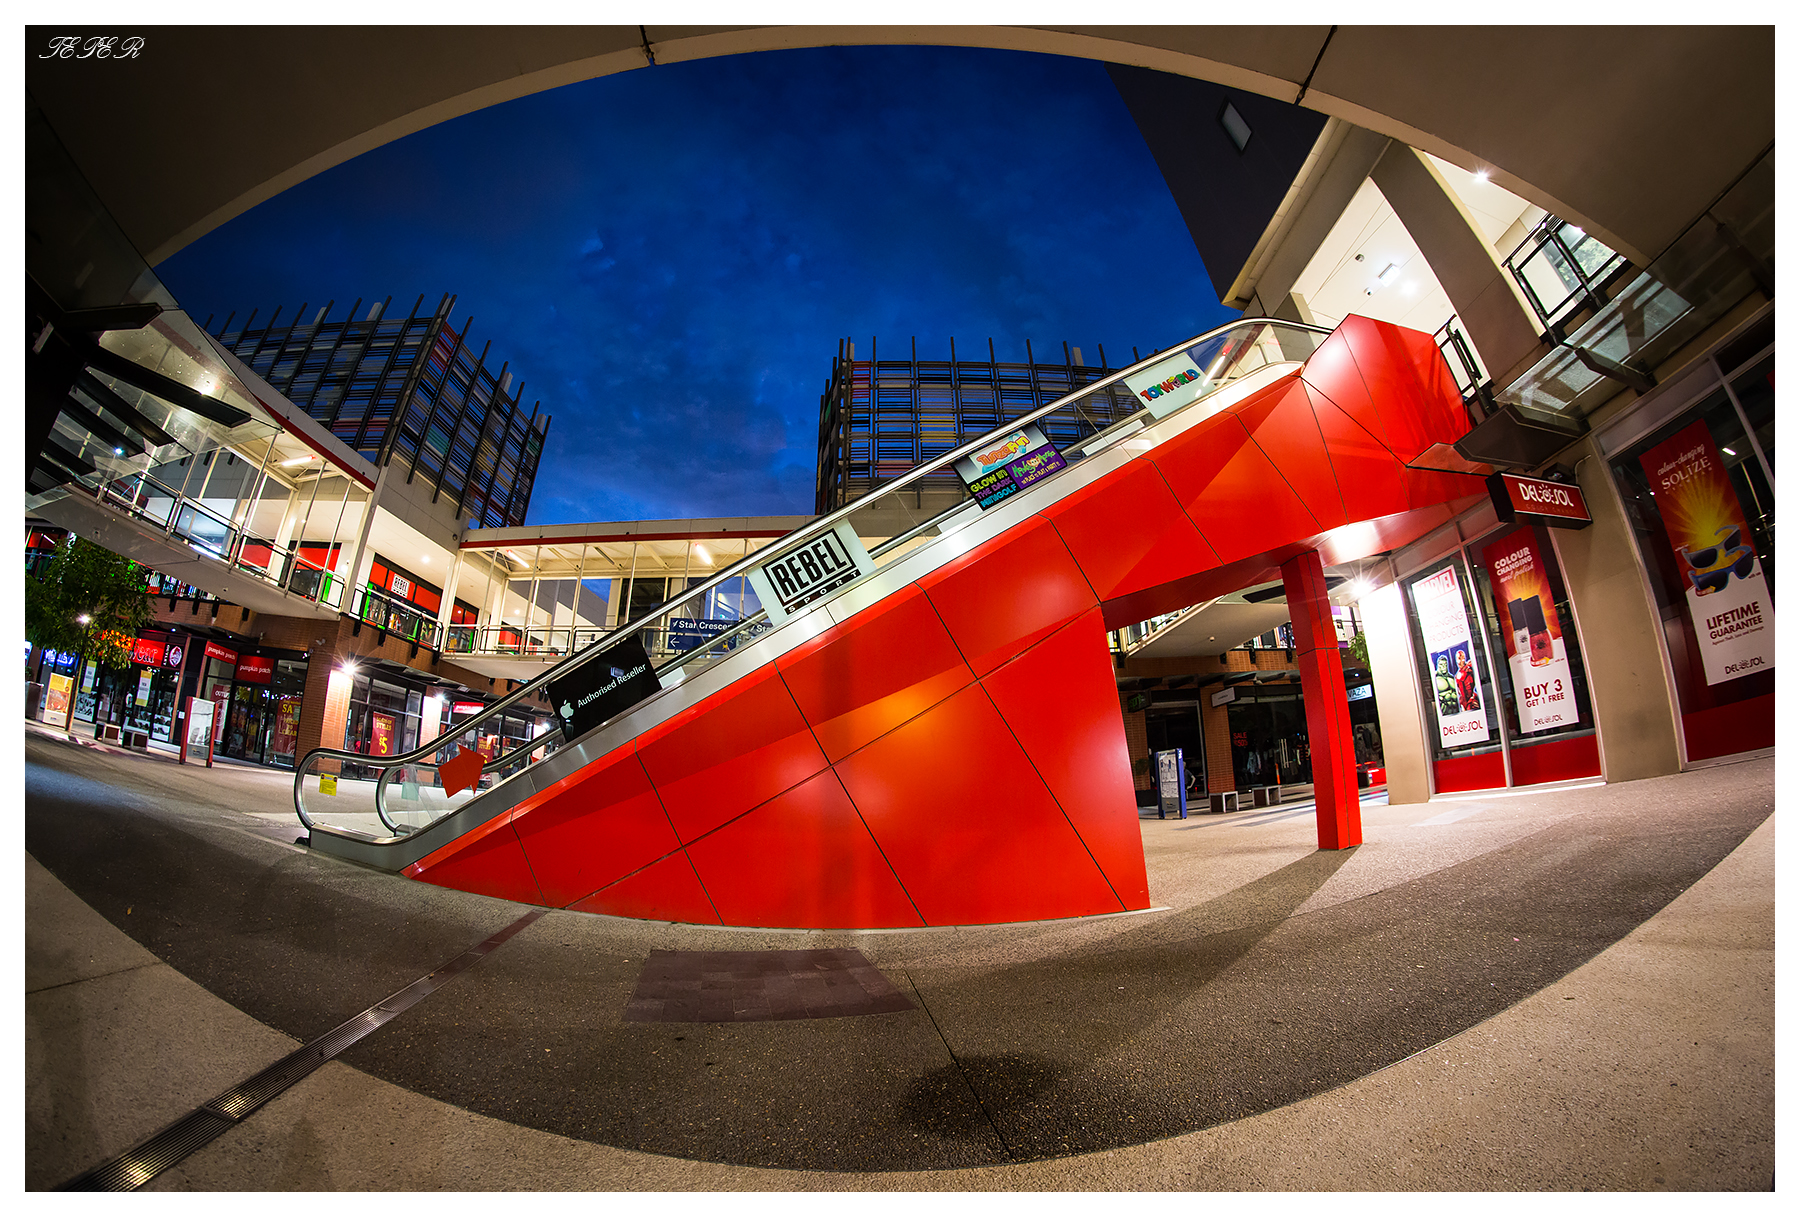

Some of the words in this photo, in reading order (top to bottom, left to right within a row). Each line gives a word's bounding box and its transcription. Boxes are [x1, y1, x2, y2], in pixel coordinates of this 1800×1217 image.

[1139, 368, 1200, 402] TOYWORLD
[970, 474, 997, 492] GLOW
[975, 487, 992, 499] THE
[991, 476, 1013, 491] DARK
[770, 538, 847, 598] REBEL
[1494, 546, 1531, 569] COLOUR
[1496, 555, 1533, 576] CHANGING
[788, 571, 858, 613] SPORT
[678, 620, 697, 629] Star
[1706, 601, 1761, 630] LIFETIME
[1709, 614, 1763, 640] GUARANTEE
[207, 646, 225, 657] pumpkin
[225, 652, 236, 660] patch
[239, 664, 258, 672] pumpkin
[577, 679, 617, 708] Authorised
[616, 663, 647, 685] Reseller
[1523, 682, 1549, 700] BUY
[1554, 678, 1563, 692] 3
[1525, 698, 1539, 708] GET
[1548, 692, 1565, 703] FREE
